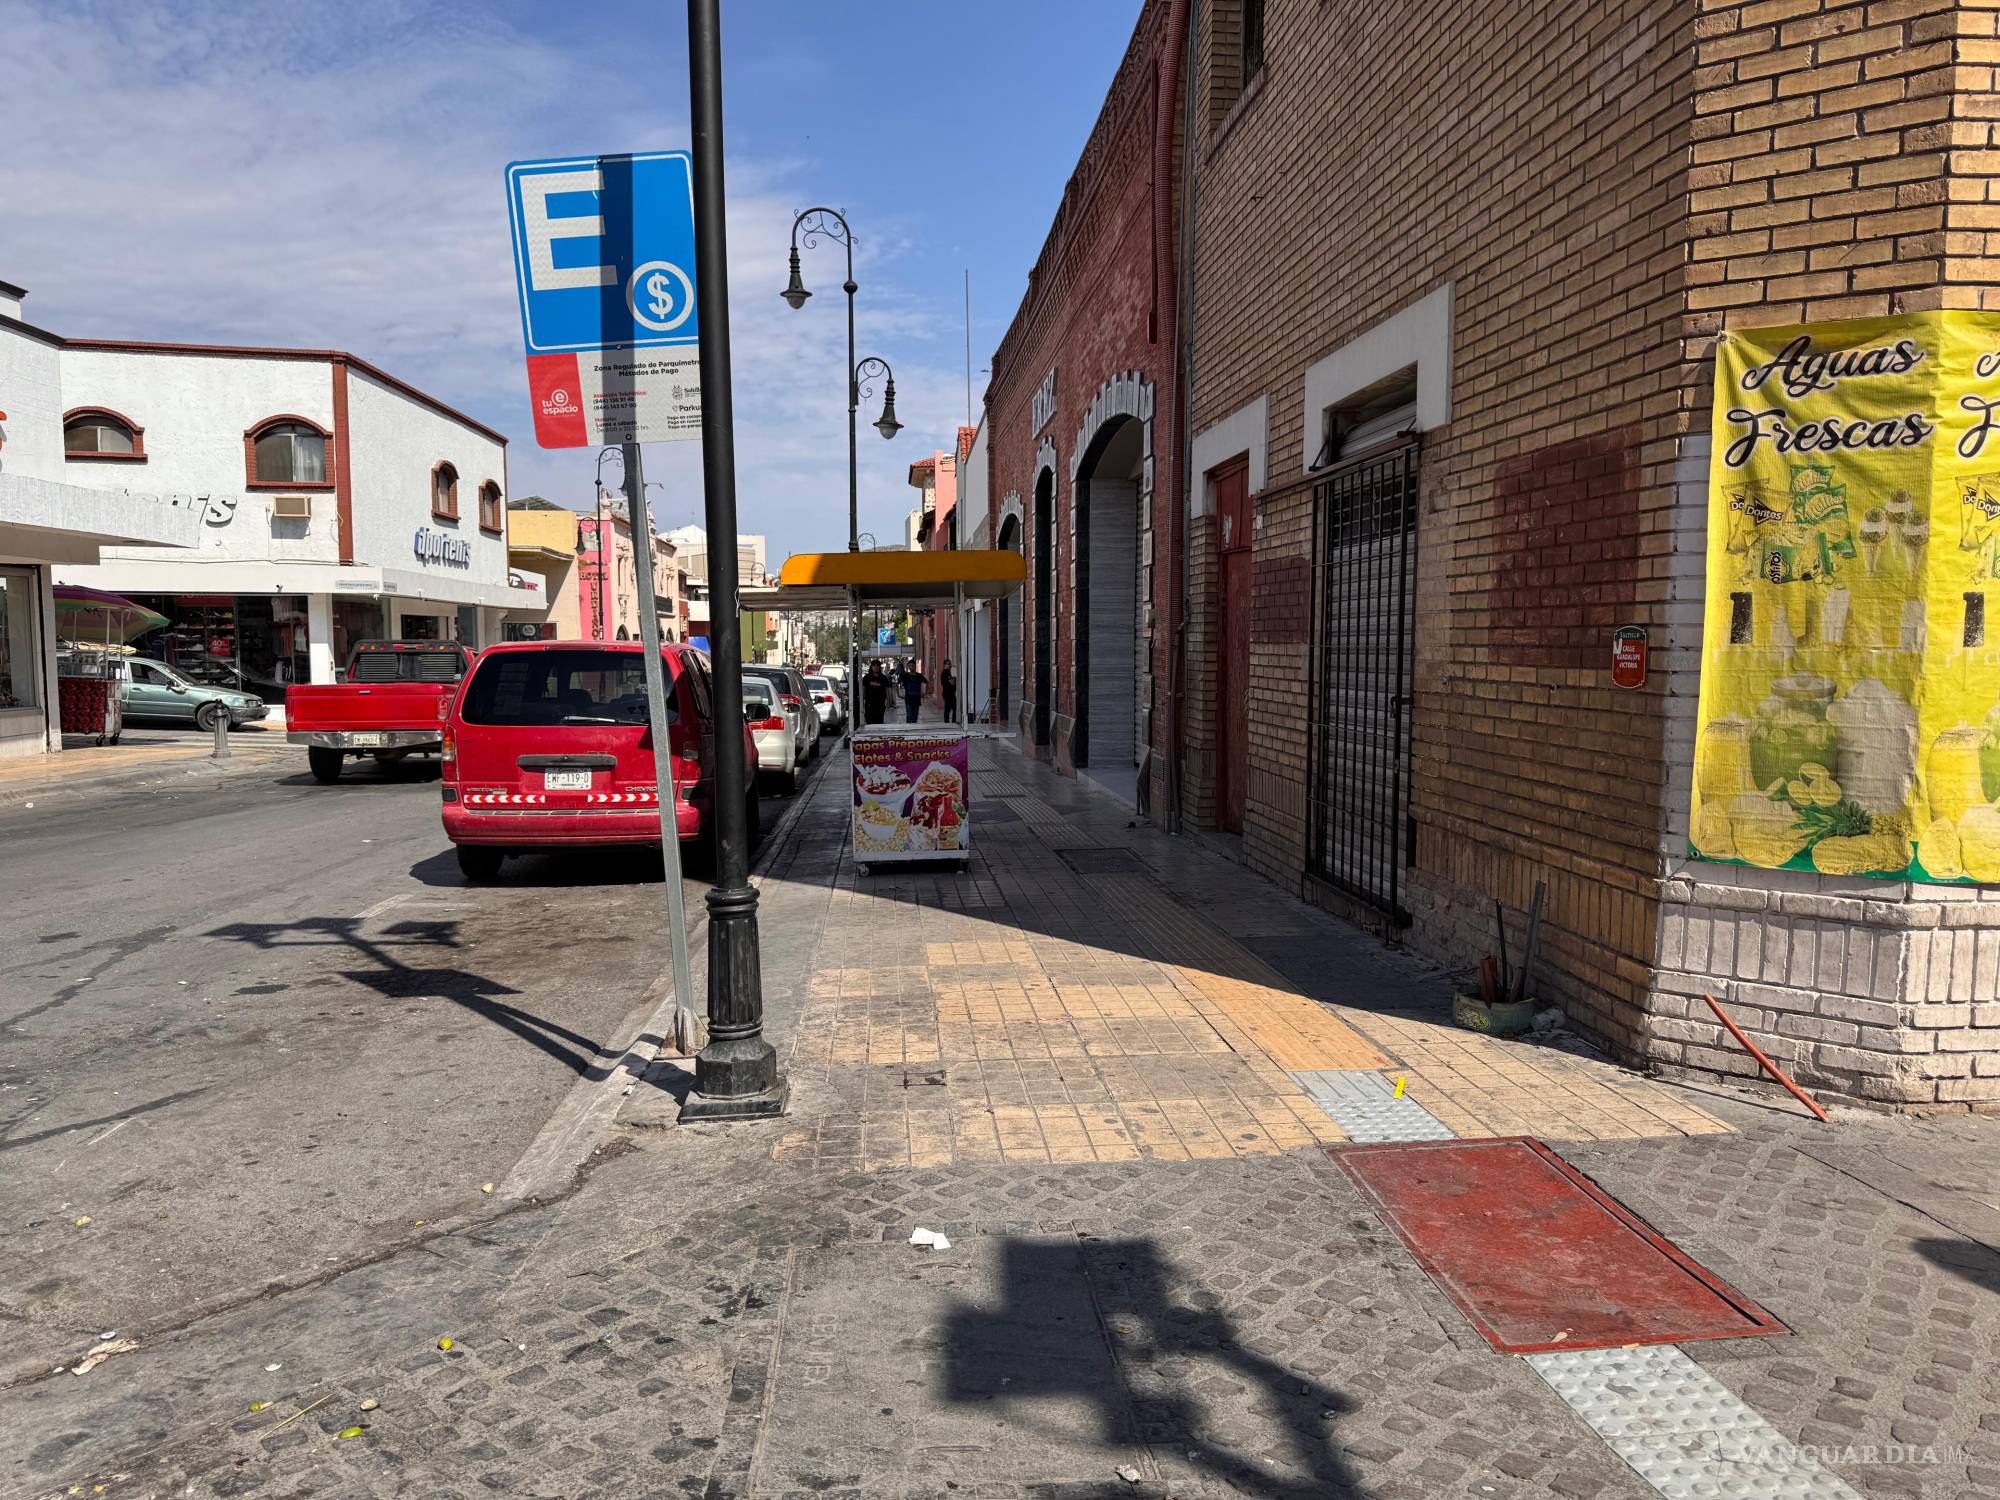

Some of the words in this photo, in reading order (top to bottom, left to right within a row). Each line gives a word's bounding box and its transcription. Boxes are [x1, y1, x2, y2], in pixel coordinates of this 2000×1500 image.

[519, 169, 618, 291] E
[619, 369, 649, 377] Métodos
[661, 368, 679, 376] Pago
[1741, 335, 1924, 398] Aguas
[543, 404, 579, 415] espacio
[1725, 408, 1934, 468] Frescas
[1747, 505, 1784, 521] Doritos
[853, 740, 885, 753] apas
[854, 754, 891, 765] Elotes
[895, 751, 903, 762] &
[907, 750, 950, 762] Snacks
